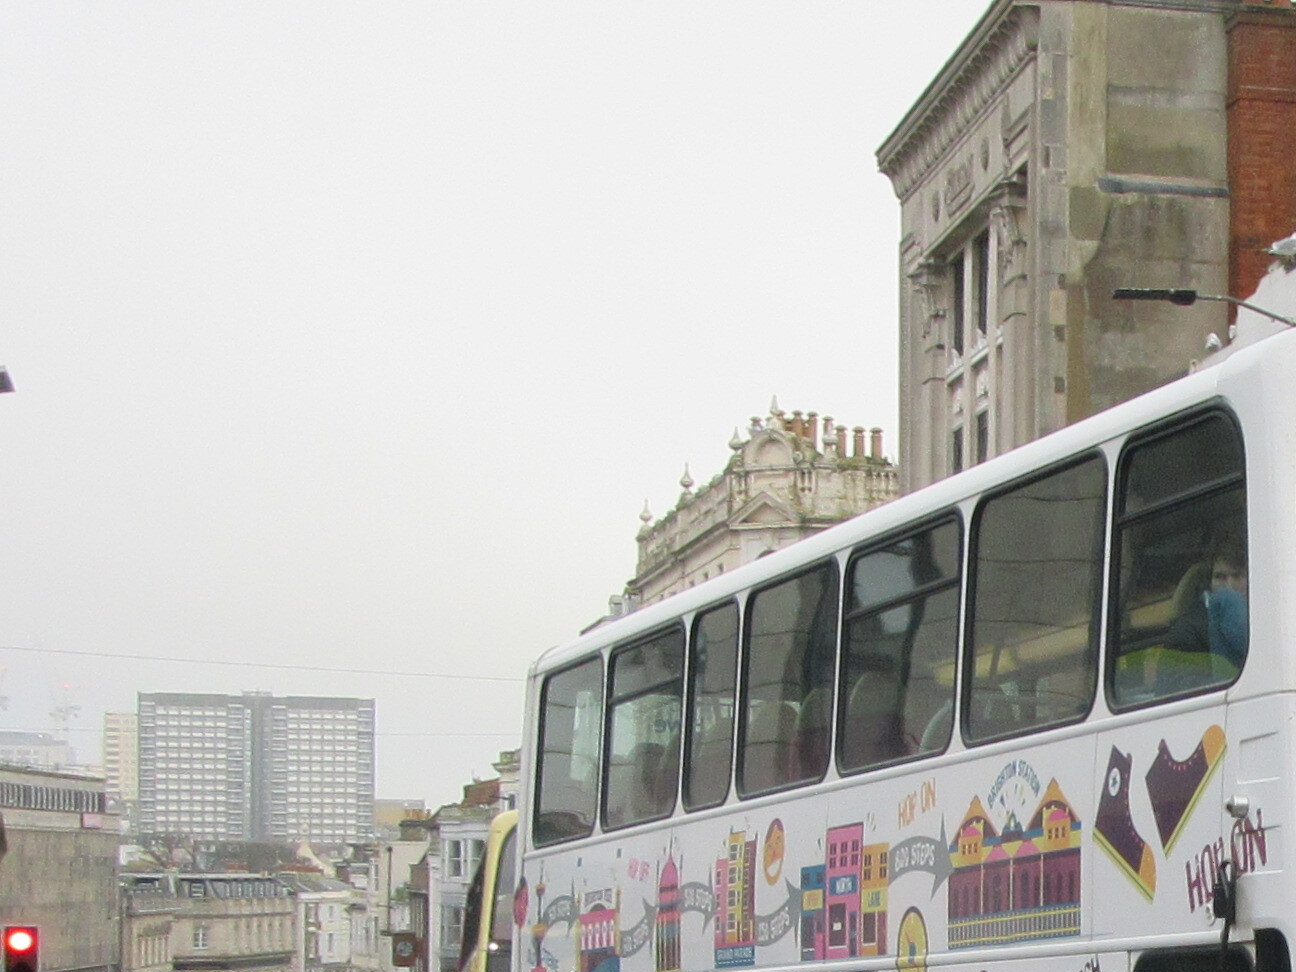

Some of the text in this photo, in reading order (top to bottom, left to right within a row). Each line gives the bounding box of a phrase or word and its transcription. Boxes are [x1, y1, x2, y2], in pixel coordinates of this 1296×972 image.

[920, 778, 936, 814] ON
[911, 841, 936, 867] STEPS
[1229, 807, 1268, 875] ON
